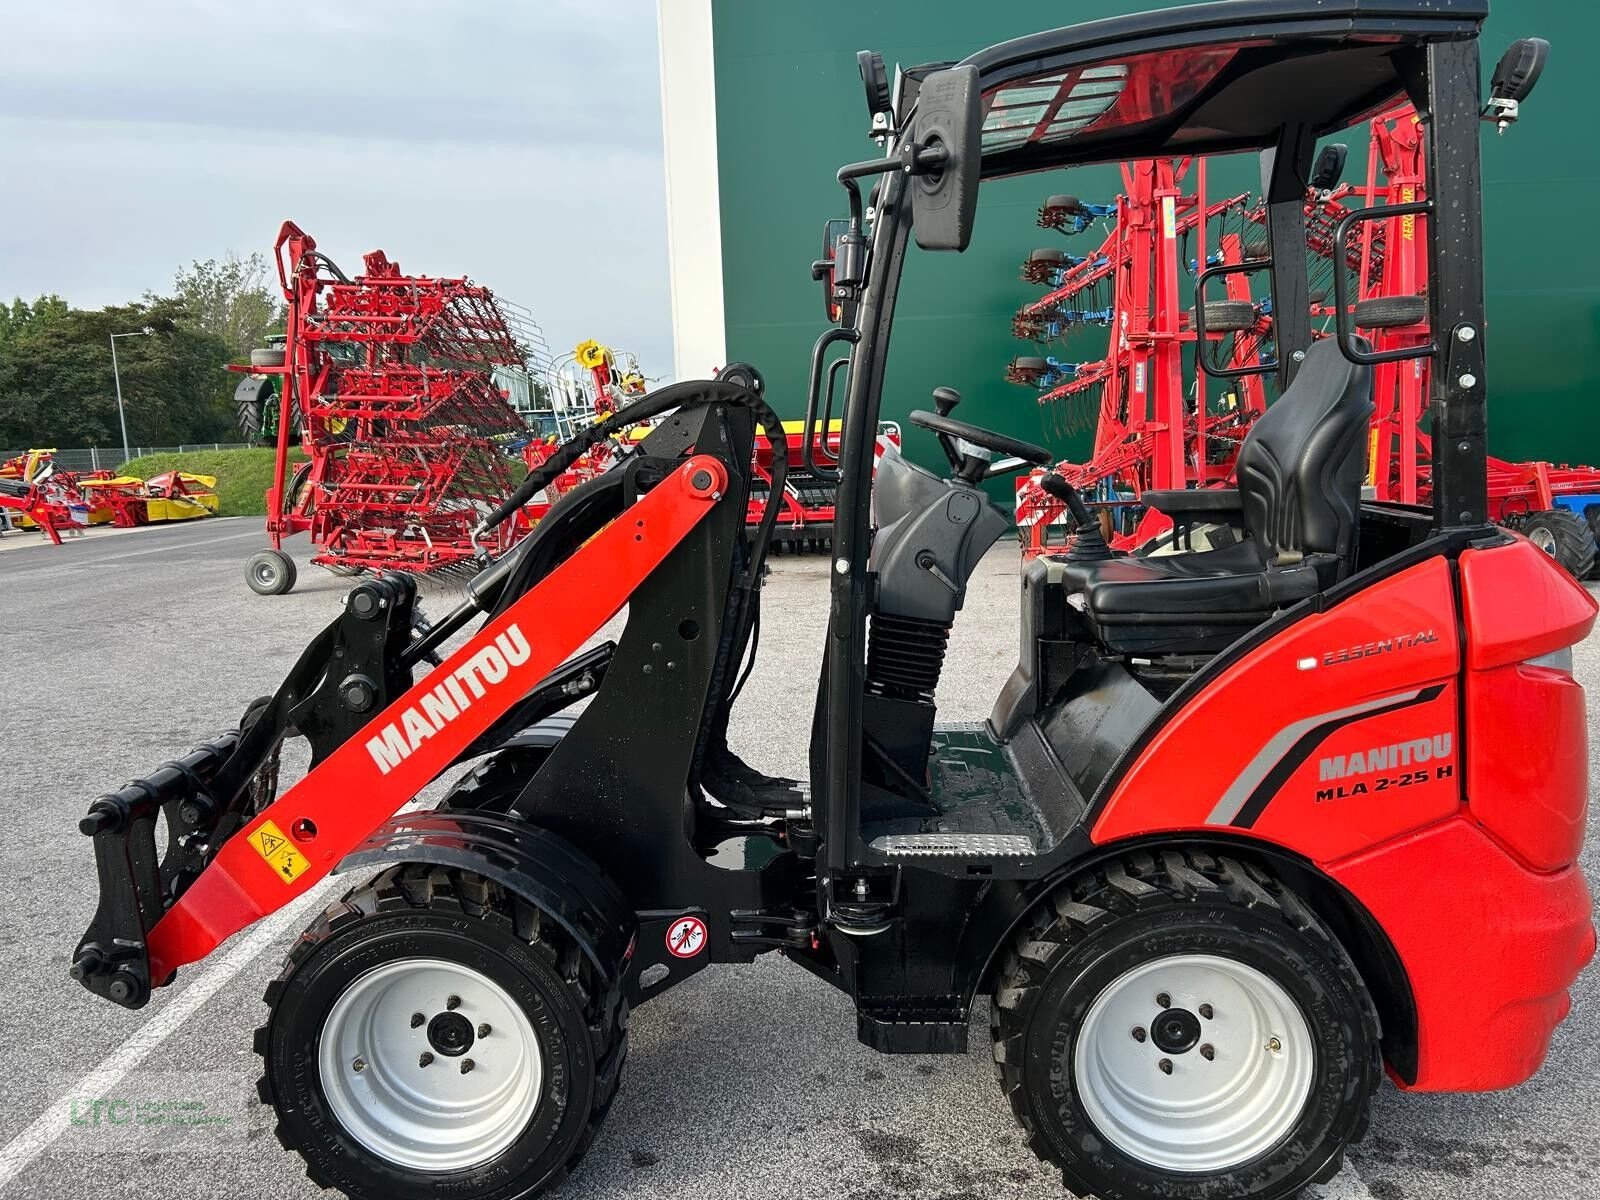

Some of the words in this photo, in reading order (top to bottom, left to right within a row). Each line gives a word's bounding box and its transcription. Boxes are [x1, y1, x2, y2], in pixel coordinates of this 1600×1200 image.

[1403, 188, 1415, 240] AEROAR
[1323, 629, 1439, 666] ESSENTIAL
[365, 623, 532, 776] MANITOU
[1319, 732, 1453, 782] MANITOU
[1315, 782, 1368, 803] MLA
[1374, 770, 1430, 792] 2-25
[1436, 764, 1453, 780] H
